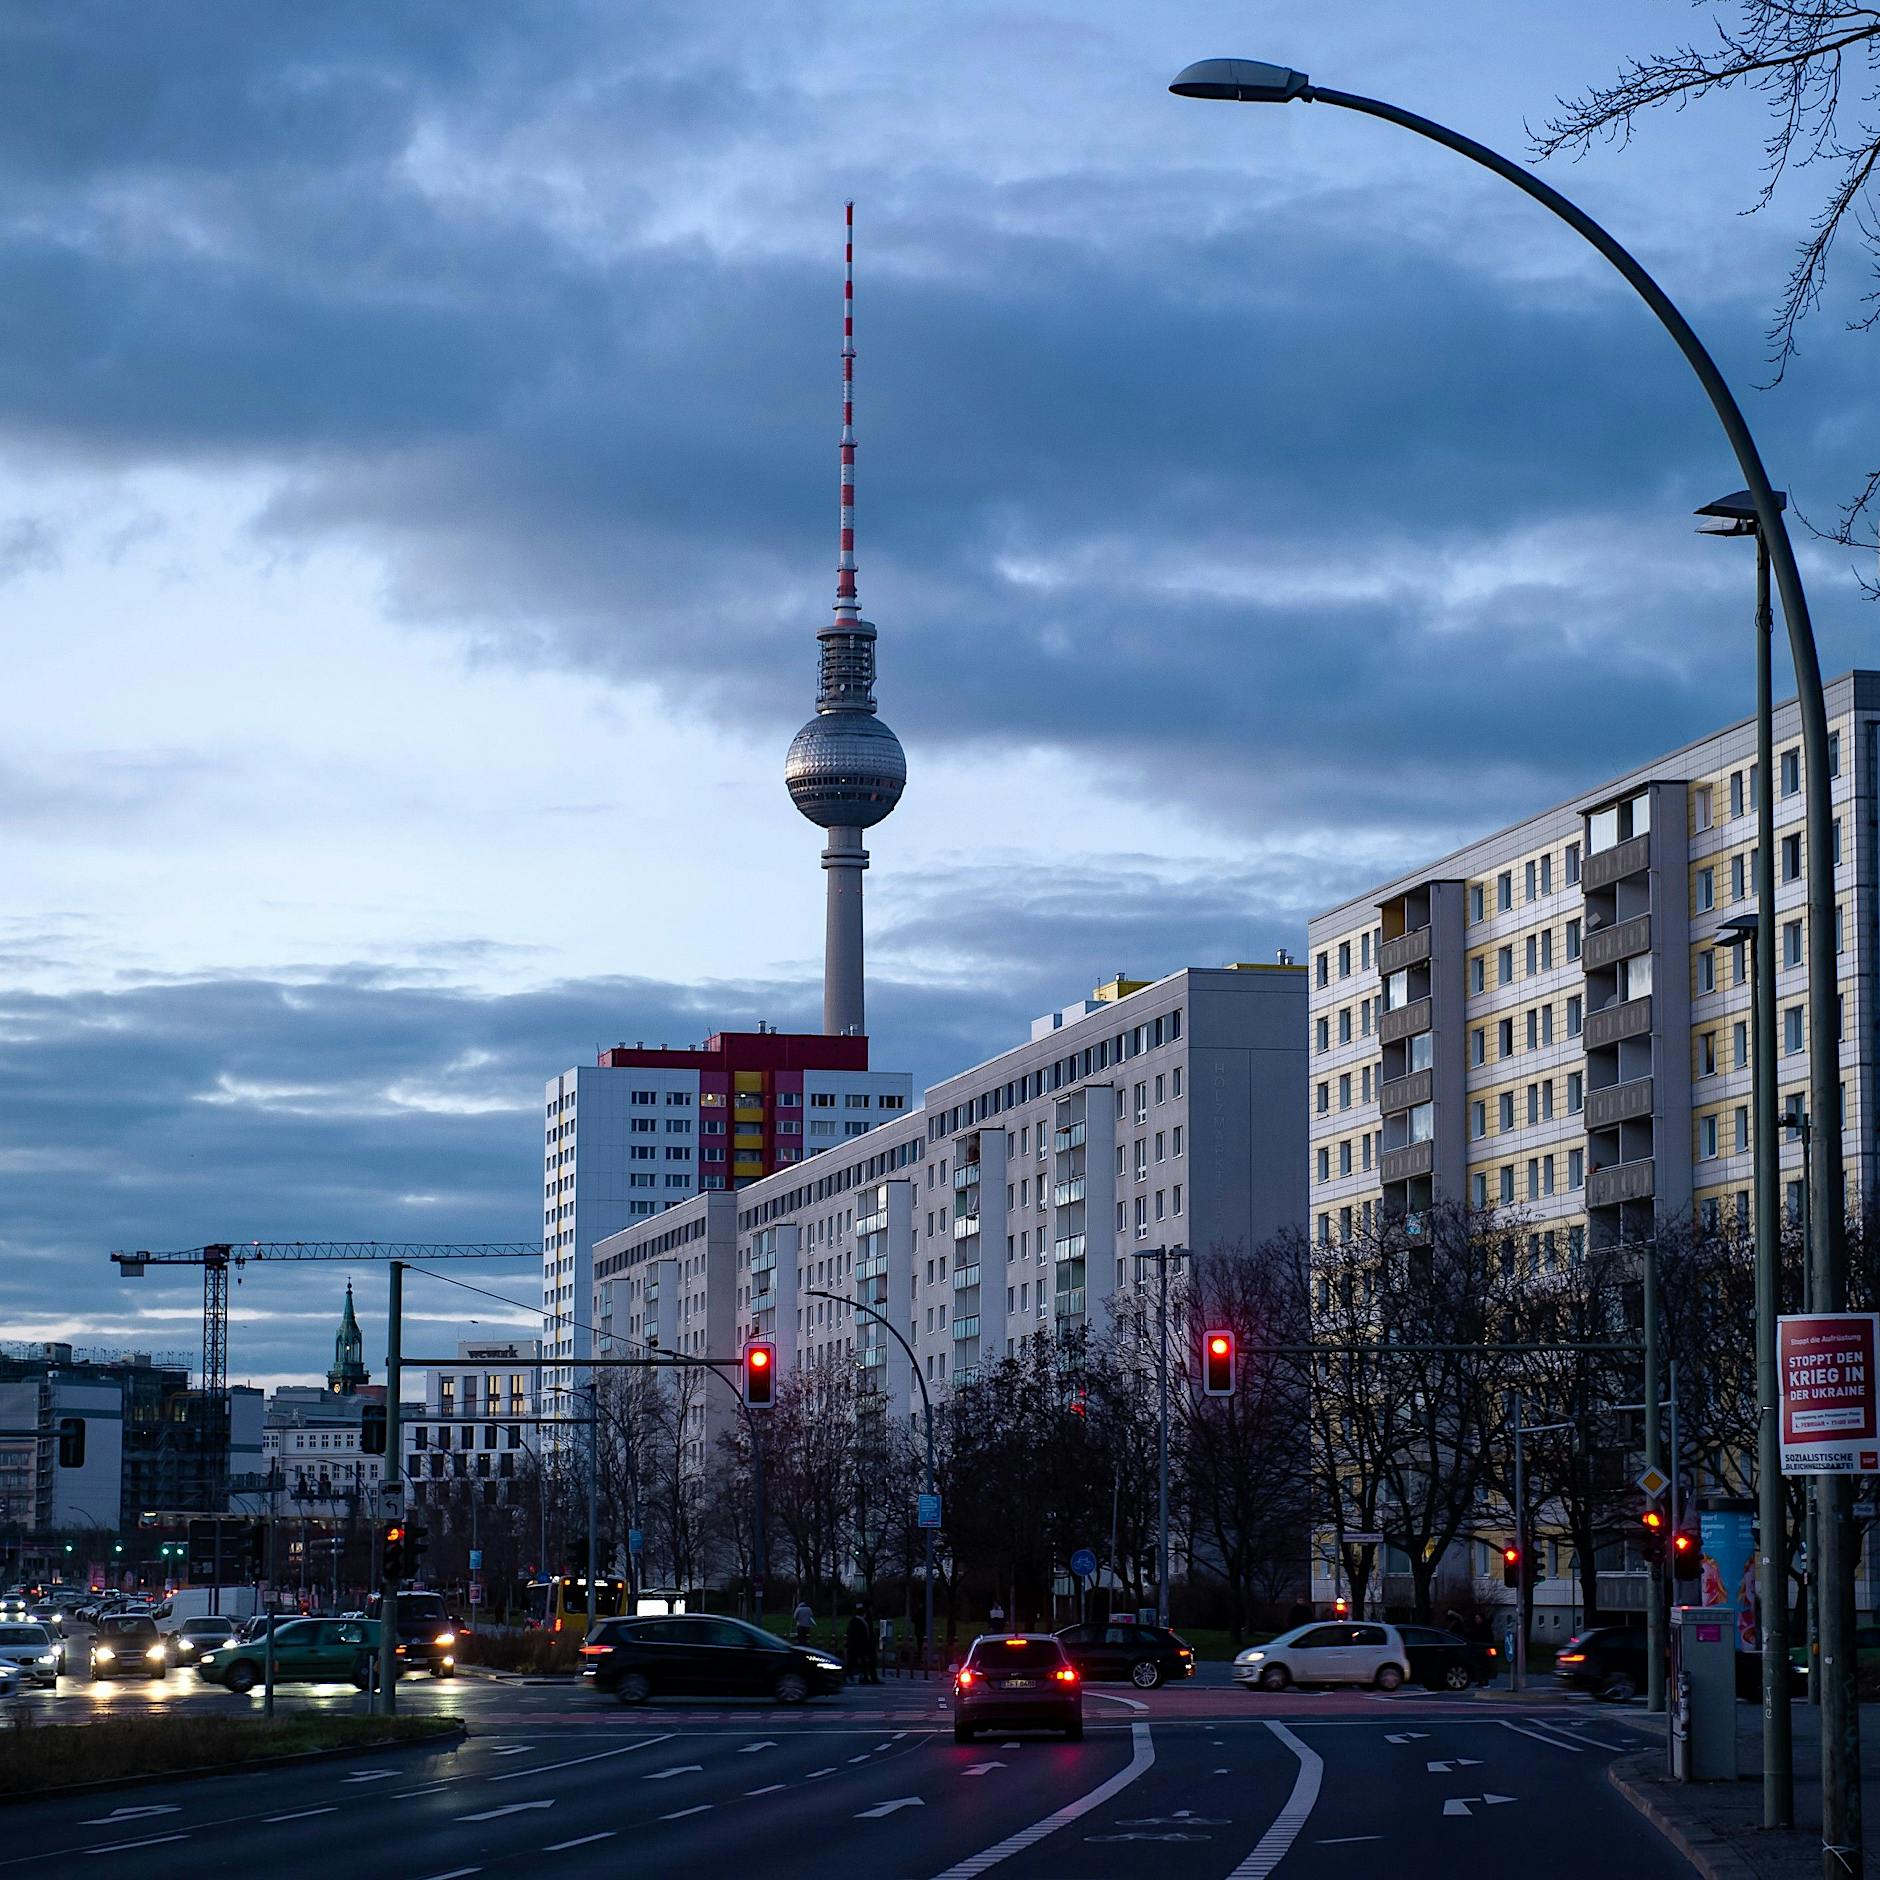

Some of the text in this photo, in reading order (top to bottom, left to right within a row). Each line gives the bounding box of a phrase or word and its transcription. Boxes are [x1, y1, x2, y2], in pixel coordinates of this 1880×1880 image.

[1789, 1351, 1863, 1368] STOPPT DEN
[1789, 1366, 1865, 1387] KRIEG IN
[1790, 1385, 1865, 1401] DER UKRAINE
[1801, 1420, 1825, 1428] FEBRUAR
[1785, 1452, 1854, 1462] SOZIALISTISCHE
